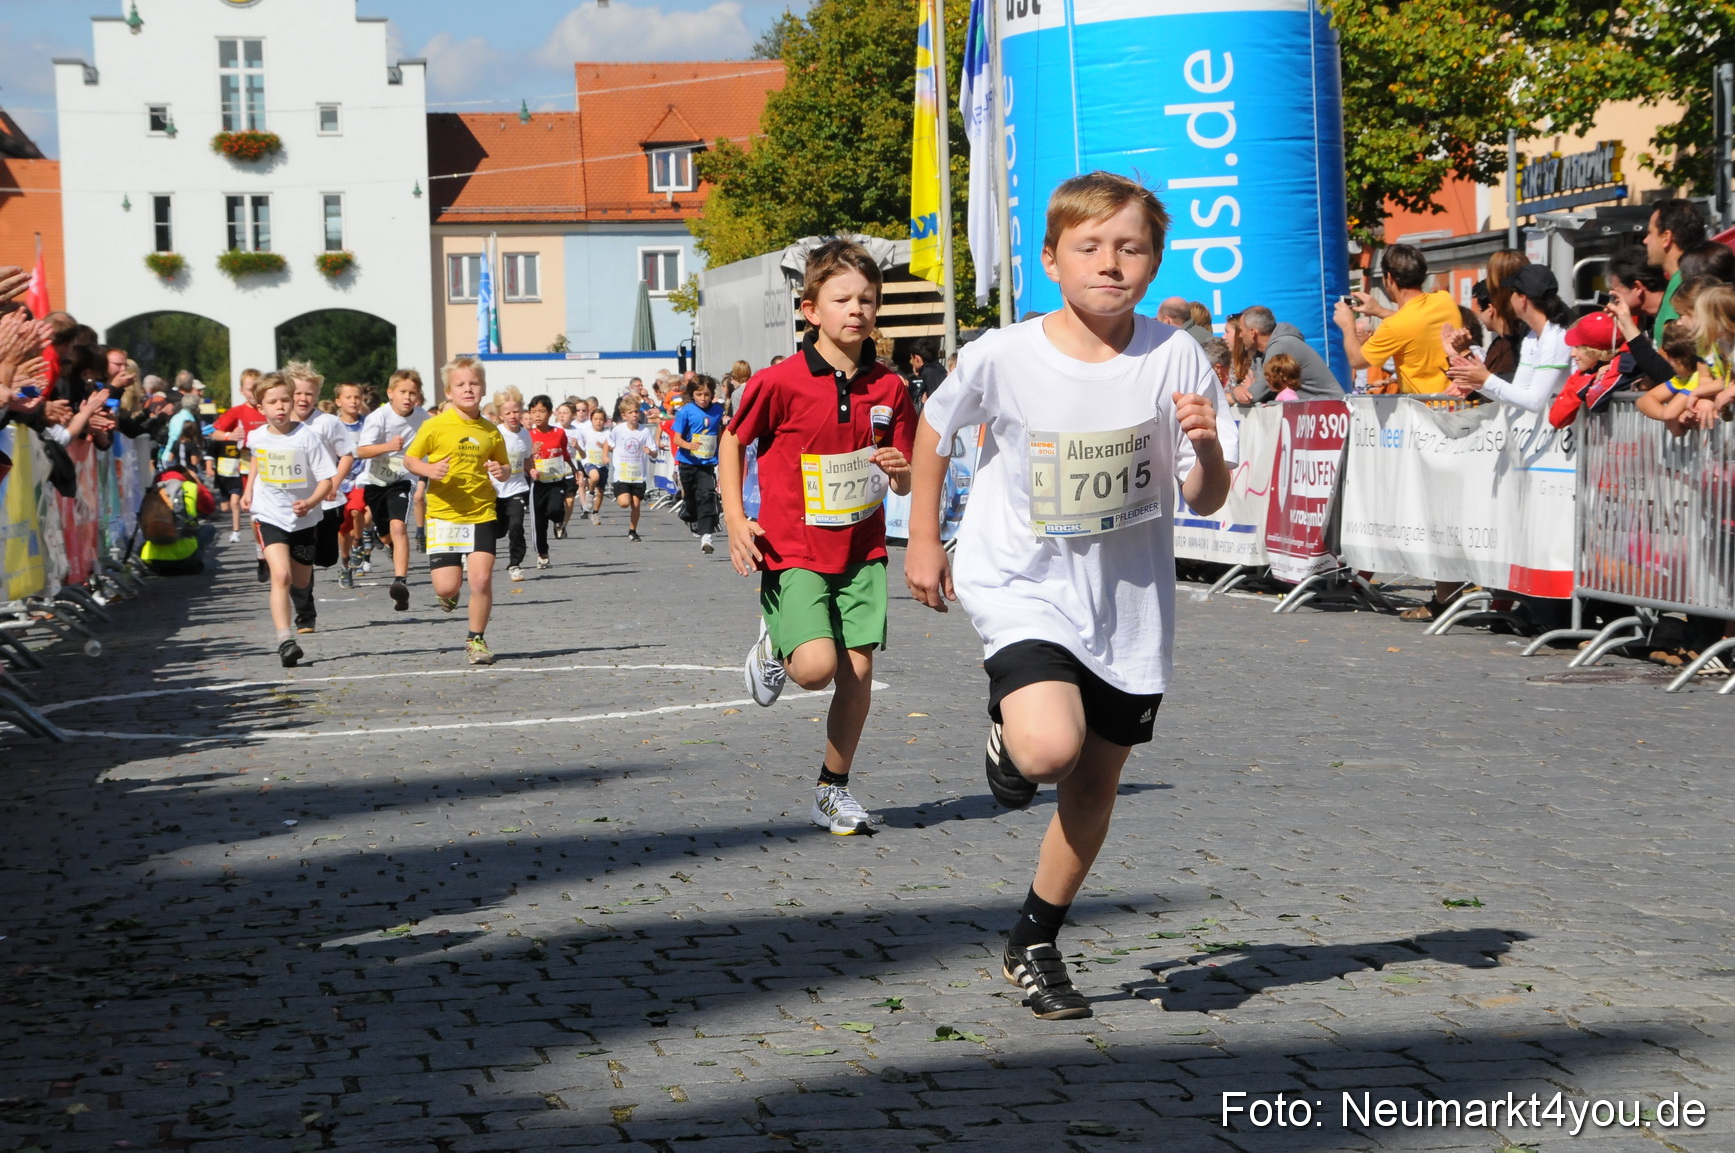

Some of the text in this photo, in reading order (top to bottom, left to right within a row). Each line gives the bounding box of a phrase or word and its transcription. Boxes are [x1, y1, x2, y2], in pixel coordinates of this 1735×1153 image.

[1319, 413, 1348, 439] 390
[1355, 418, 1375, 447] Gute
[1067, 434, 1150, 460] Alexander
[270, 464, 302, 476] 7116
[1035, 472, 1043, 486] K
[1070, 460, 1151, 501] 7015
[828, 474, 882, 501] 7278
[1115, 502, 1159, 522] PFLEIDERER
[438, 527, 469, 538] 7273
